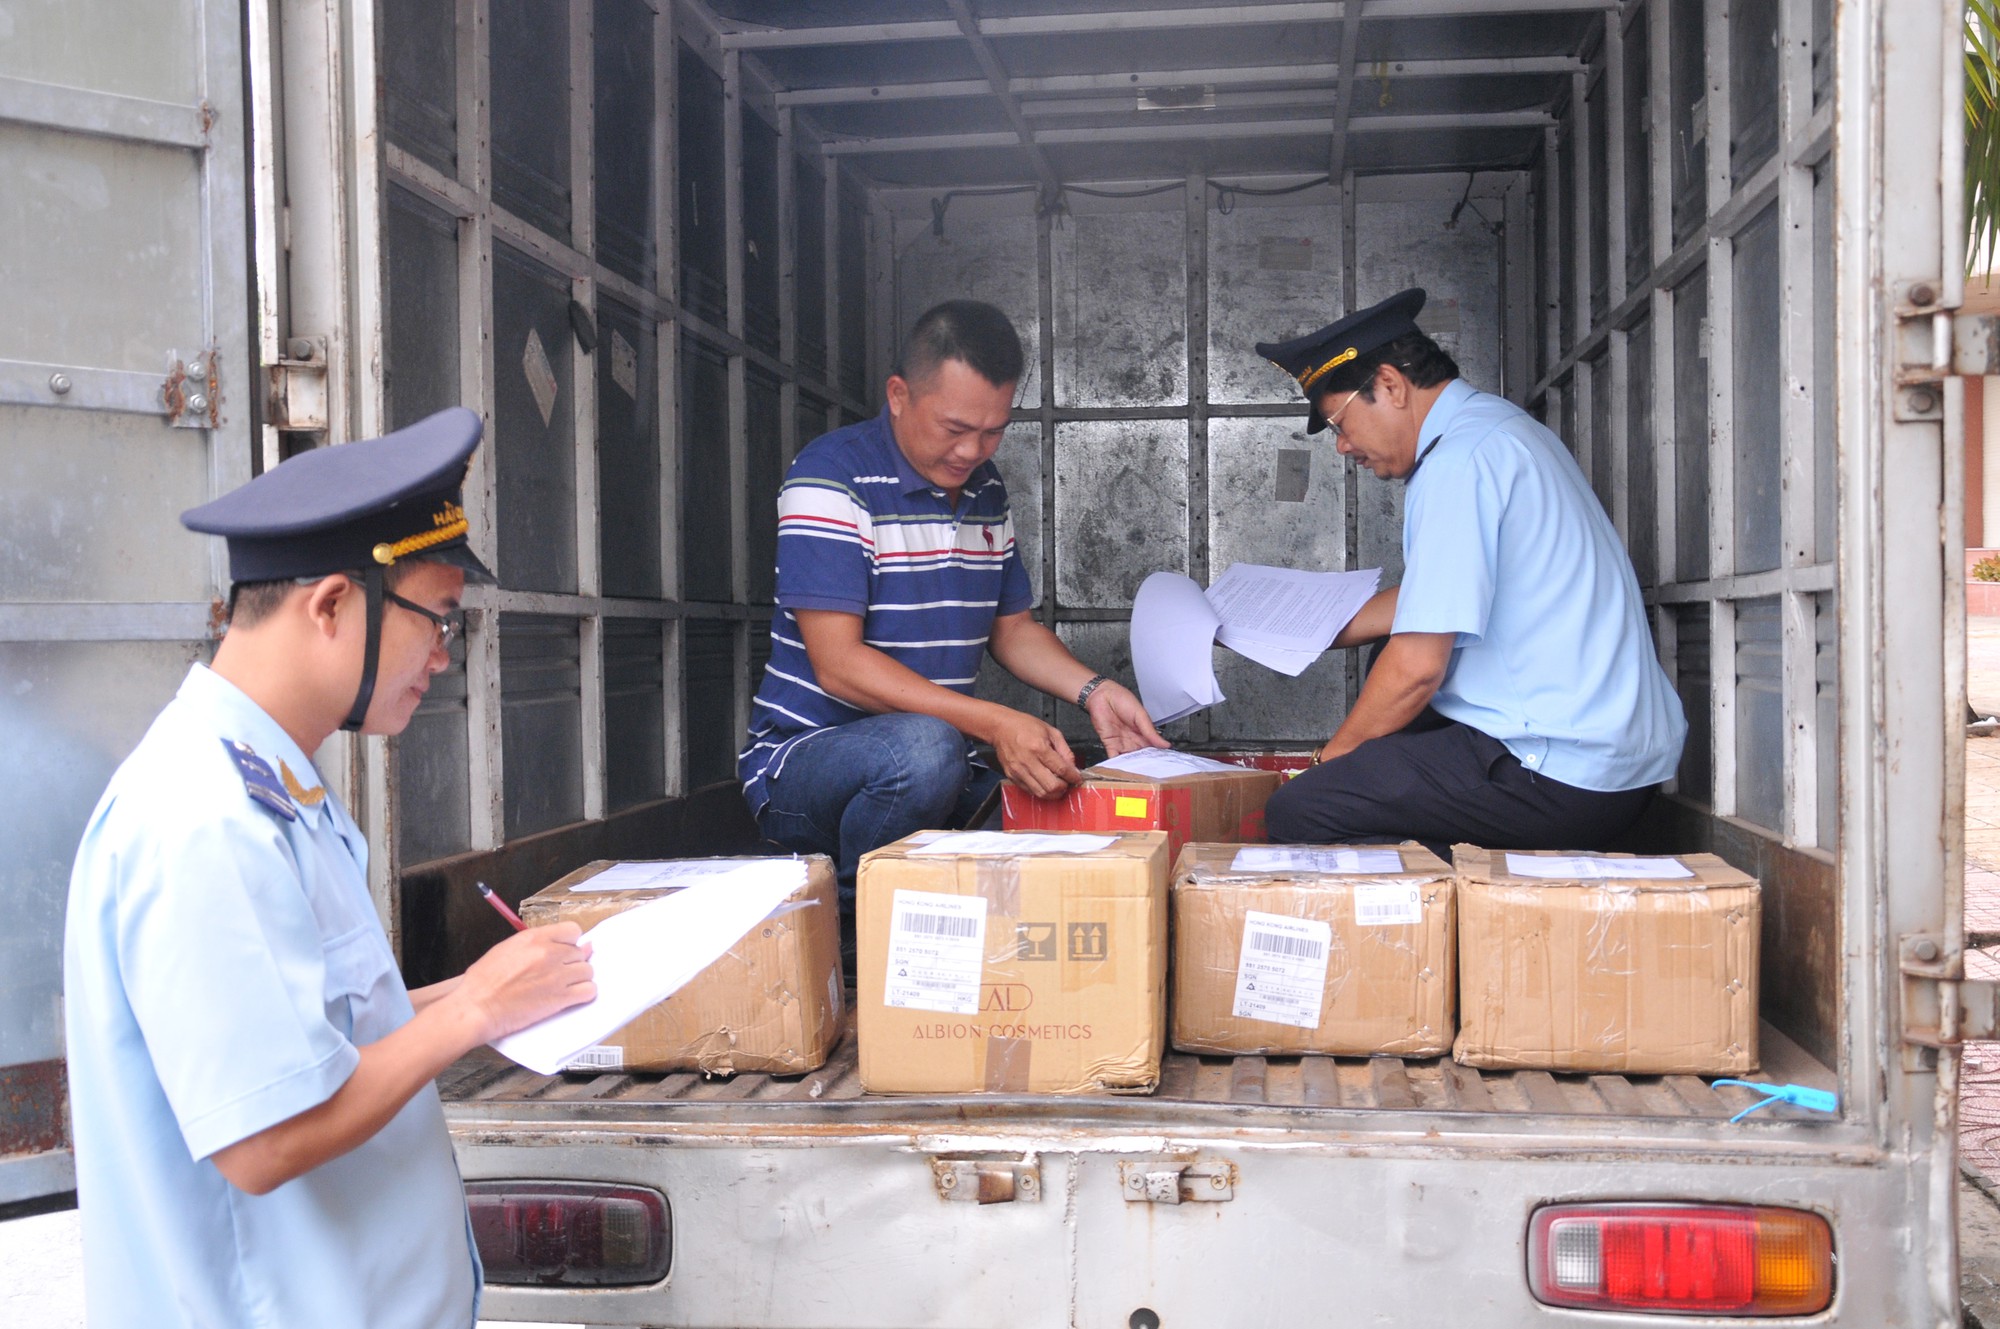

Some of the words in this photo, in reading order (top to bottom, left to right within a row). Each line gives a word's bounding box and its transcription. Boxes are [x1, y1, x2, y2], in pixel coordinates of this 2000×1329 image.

[935, 902, 962, 910] AIRLINES
[1249, 919, 1265, 927] HONG
[1266, 921, 1282, 929] KONG
[1284, 925, 1309, 933] AIRLINES
[912, 1024, 982, 1039] ALBION
[989, 1024, 1092, 1040] COSMETICS
